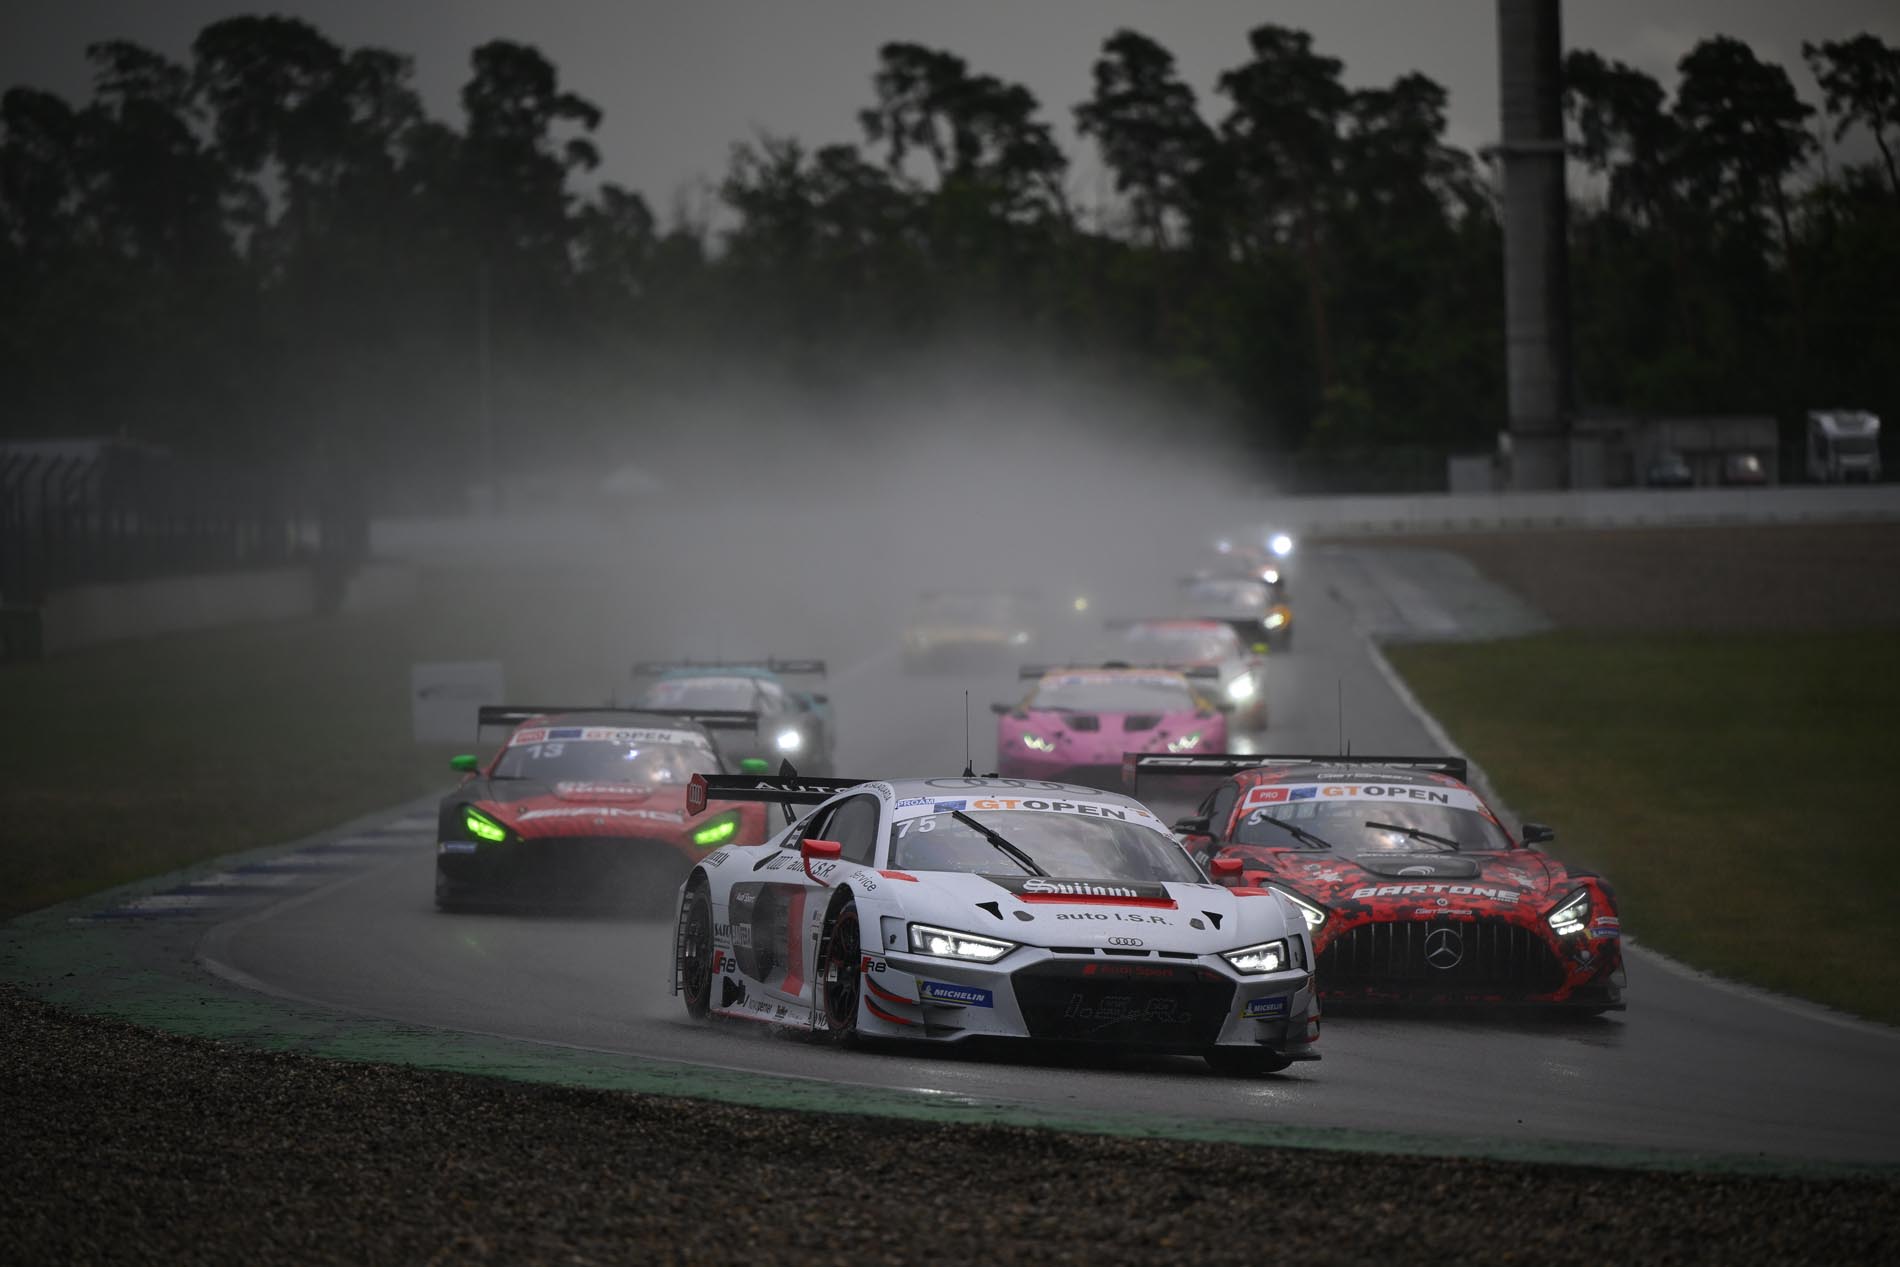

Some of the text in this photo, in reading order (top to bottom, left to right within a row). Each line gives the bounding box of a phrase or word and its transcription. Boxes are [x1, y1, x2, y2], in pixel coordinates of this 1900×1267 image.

[1260, 791, 1279, 799] PRO
[897, 816, 936, 838] 75
[1352, 885, 1520, 899] BARTONE
[1056, 911, 1174, 925] auto I.S.R.
[934, 989, 985, 1002] MICHELIN
